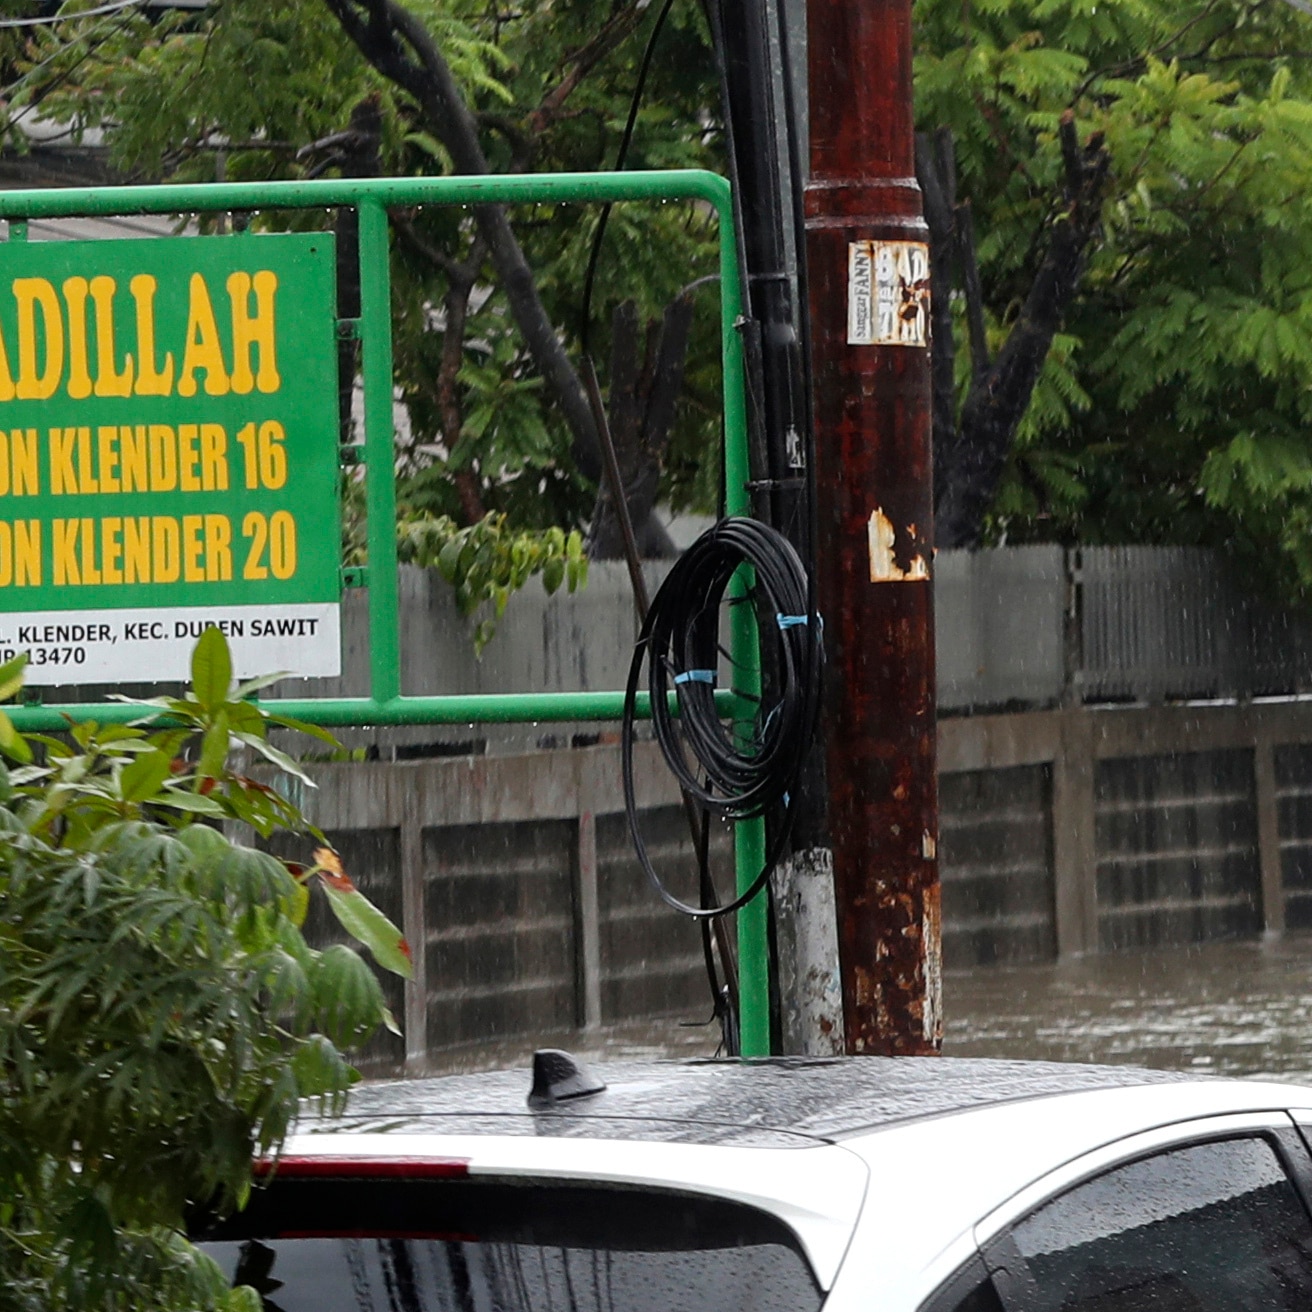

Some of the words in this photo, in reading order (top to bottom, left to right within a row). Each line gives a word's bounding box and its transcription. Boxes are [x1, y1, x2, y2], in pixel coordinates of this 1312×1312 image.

[853, 247, 871, 296] FANNY
[49, 424, 229, 496] KLENDER
[236, 420, 288, 491] 16
[52, 513, 233, 586] KLENDER
[242, 510, 296, 580] 20
[18, 624, 117, 645] KLENDER,
[124, 622, 169, 641] KEC.
[250, 618, 319, 637] SAWIT
[25, 646, 86, 666] 13470
